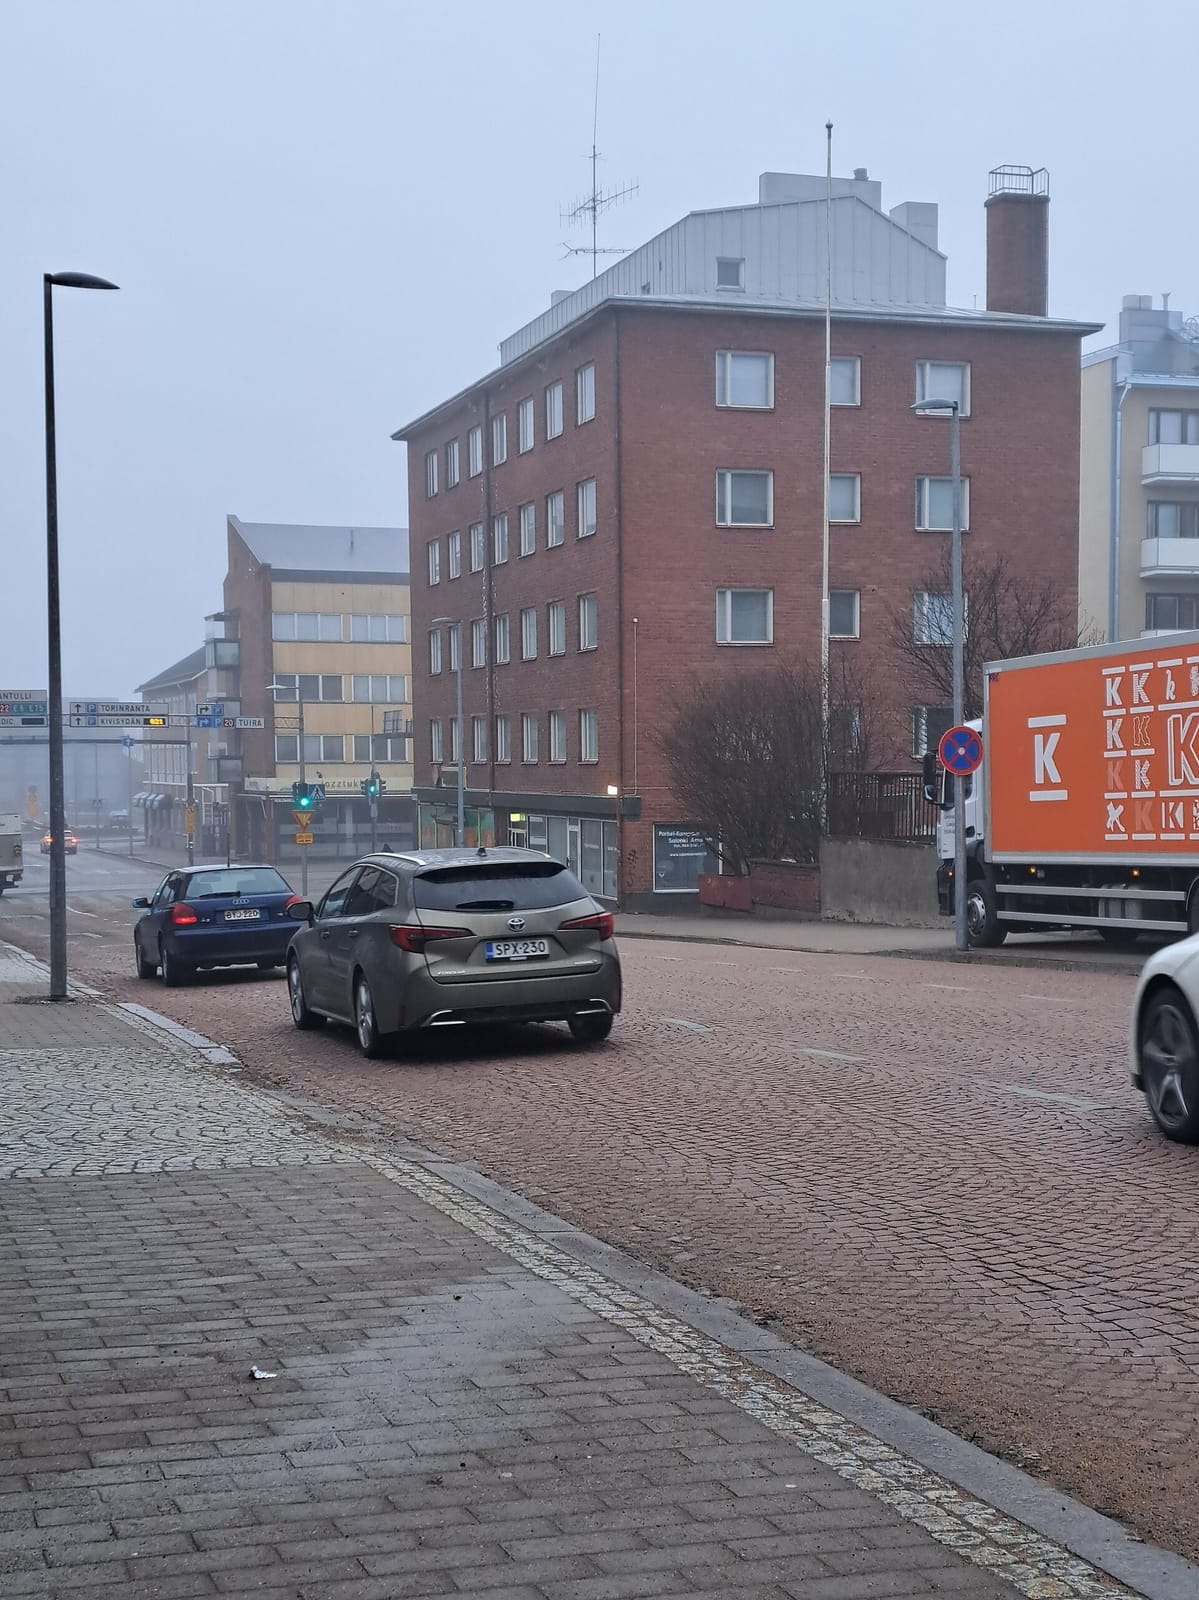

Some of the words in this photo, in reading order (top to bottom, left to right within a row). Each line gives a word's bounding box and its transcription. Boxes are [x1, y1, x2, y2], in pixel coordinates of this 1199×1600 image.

[1106, 677, 1122, 706] K
[1133, 672, 1150, 704] K
[101, 704, 150, 713] TORINRANTA
[224, 719, 234, 727] 20
[239, 719, 262, 727] TUIRA
[1107, 719, 1123, 749] K
[1133, 715, 1151, 746] K
[1034, 732, 1062, 784] K
[1108, 760, 1124, 790] K
[1135, 759, 1151, 790] K
[1136, 801, 1153, 831] K
[495, 941, 546, 955] SPX-230
